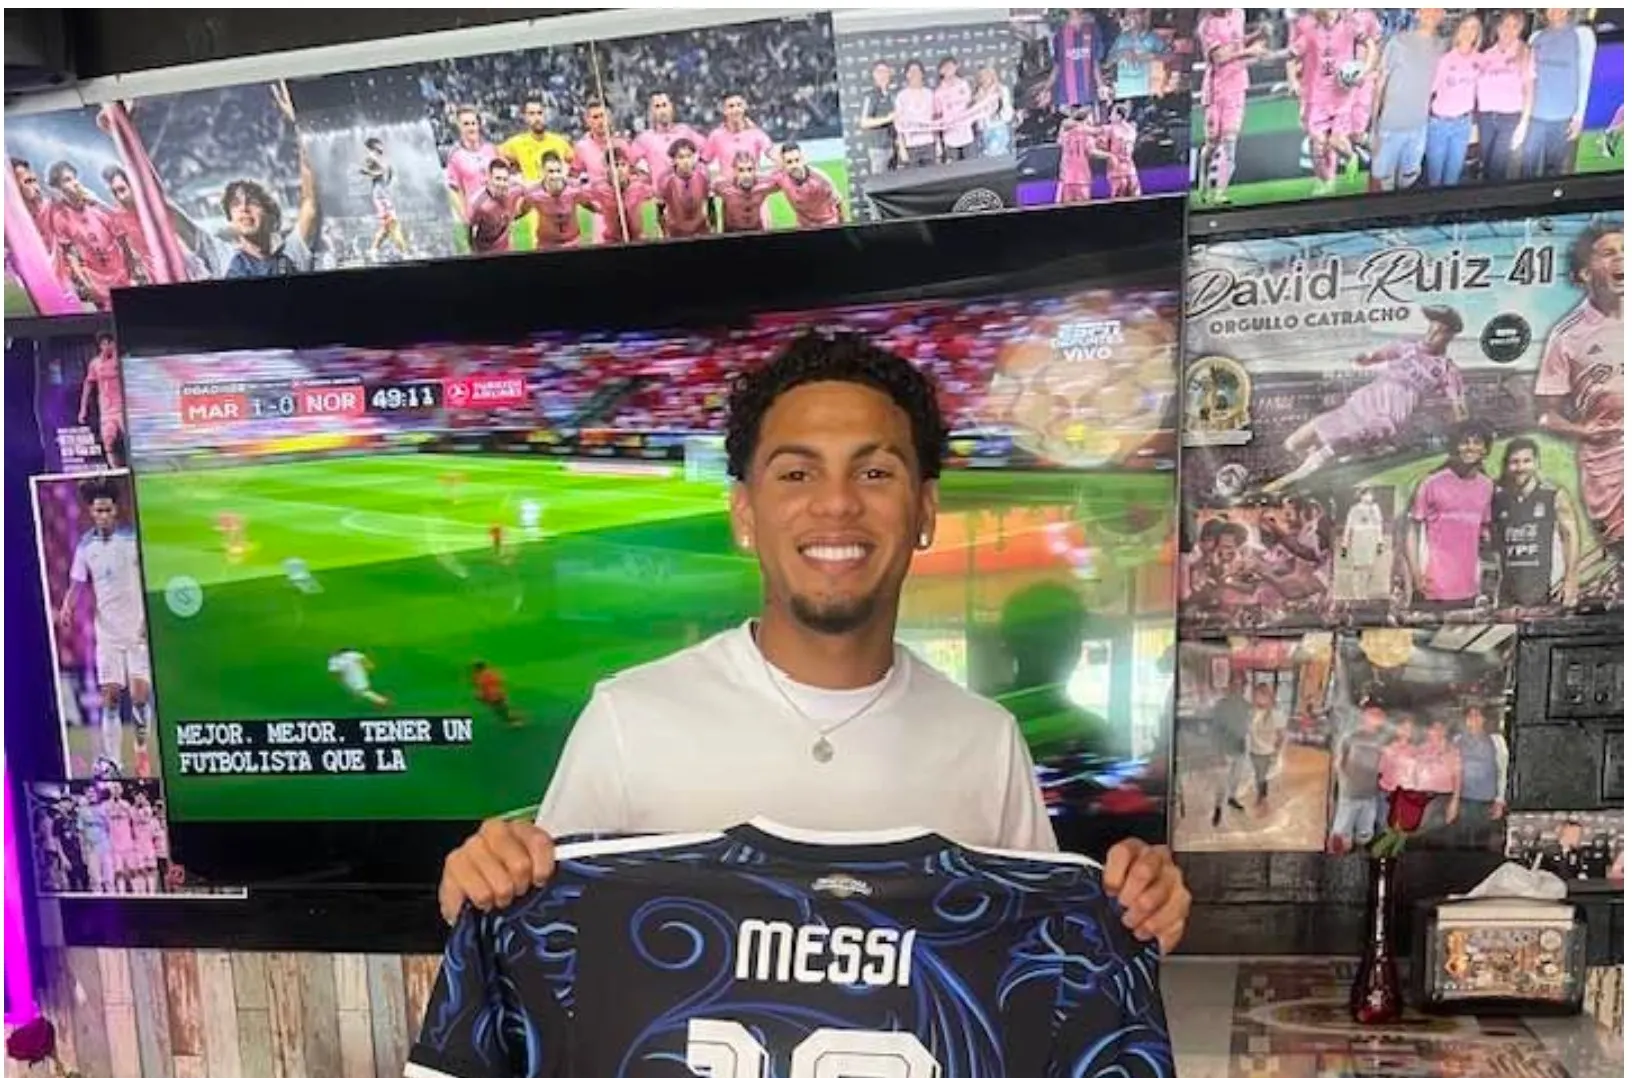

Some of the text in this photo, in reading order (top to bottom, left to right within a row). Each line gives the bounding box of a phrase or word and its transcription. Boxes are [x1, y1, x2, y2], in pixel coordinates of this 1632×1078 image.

[1186, 247, 1553, 319] David Ruiz 41
[1209, 306, 1411, 336] ORGULLO CATRACHO
[187, 402, 240, 421] MAR
[306, 391, 357, 413] NOR
[371, 387, 434, 409] 49:11
[176, 718, 473, 745] MEJOR. MEJOR. TENER UN
[179, 748, 407, 773] FUTBOLISTA QUE LA
[735, 918, 917, 987] MESSI
